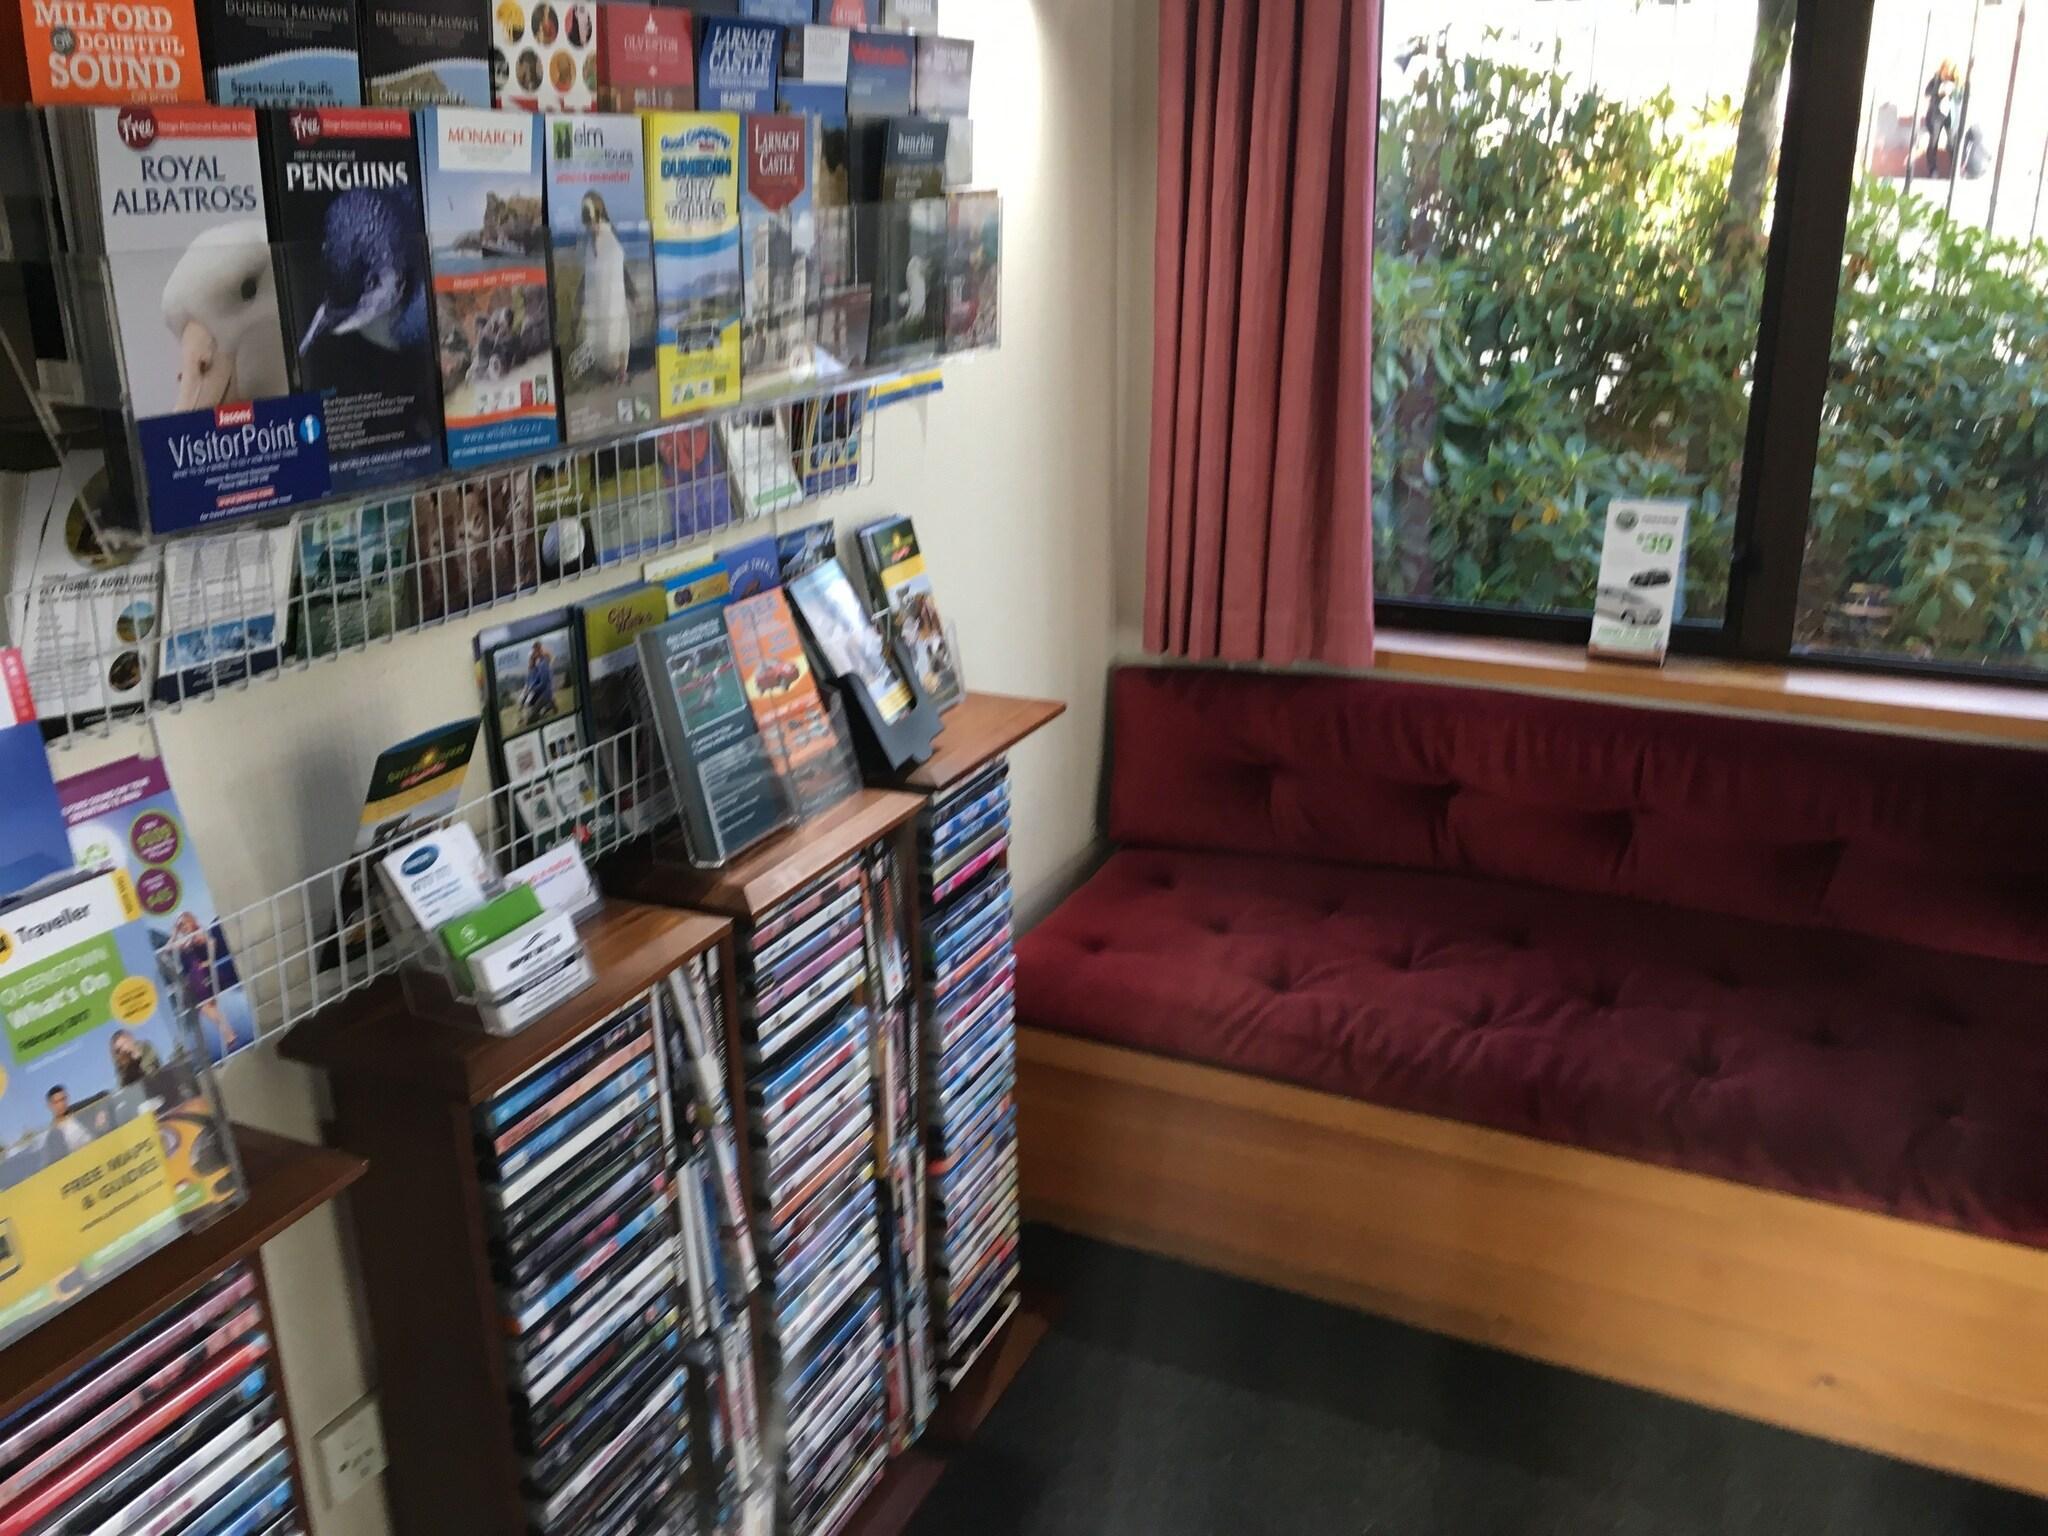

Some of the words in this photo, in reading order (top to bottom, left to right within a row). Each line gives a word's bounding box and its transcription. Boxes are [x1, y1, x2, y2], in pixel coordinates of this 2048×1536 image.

[34, 2, 173, 32] MILFORD
[225, 0, 287, 18] DUNEDIN
[291, 3, 349, 24] RAILWAYS
[375, 10, 428, 27] DUNEDIN
[429, 14, 479, 32] RAILWAYS
[79, 31, 185, 57] DOUBTFUL
[712, 26, 776, 50] LARNACH
[49, 54, 182, 90] SOUND
[709, 47, 772, 75] CASTLE
[231, 79, 295, 97] Spectacular
[299, 80, 334, 96] Pacific
[118, 112, 155, 145] Free
[291, 113, 320, 142] Free
[448, 127, 524, 146] MONARCH
[573, 121, 605, 148] elm
[141, 155, 227, 183] ROYAL
[286, 161, 409, 192] PENGUINS
[660, 156, 732, 179] DUNEDIN
[112, 185, 257, 215] ALBATROSS
[168, 418, 298, 469] VisitorPoint
[15, 903, 91, 944] Traveller
[62, 1165, 104, 1200] FREE
[106, 1137, 154, 1172] MAPS
